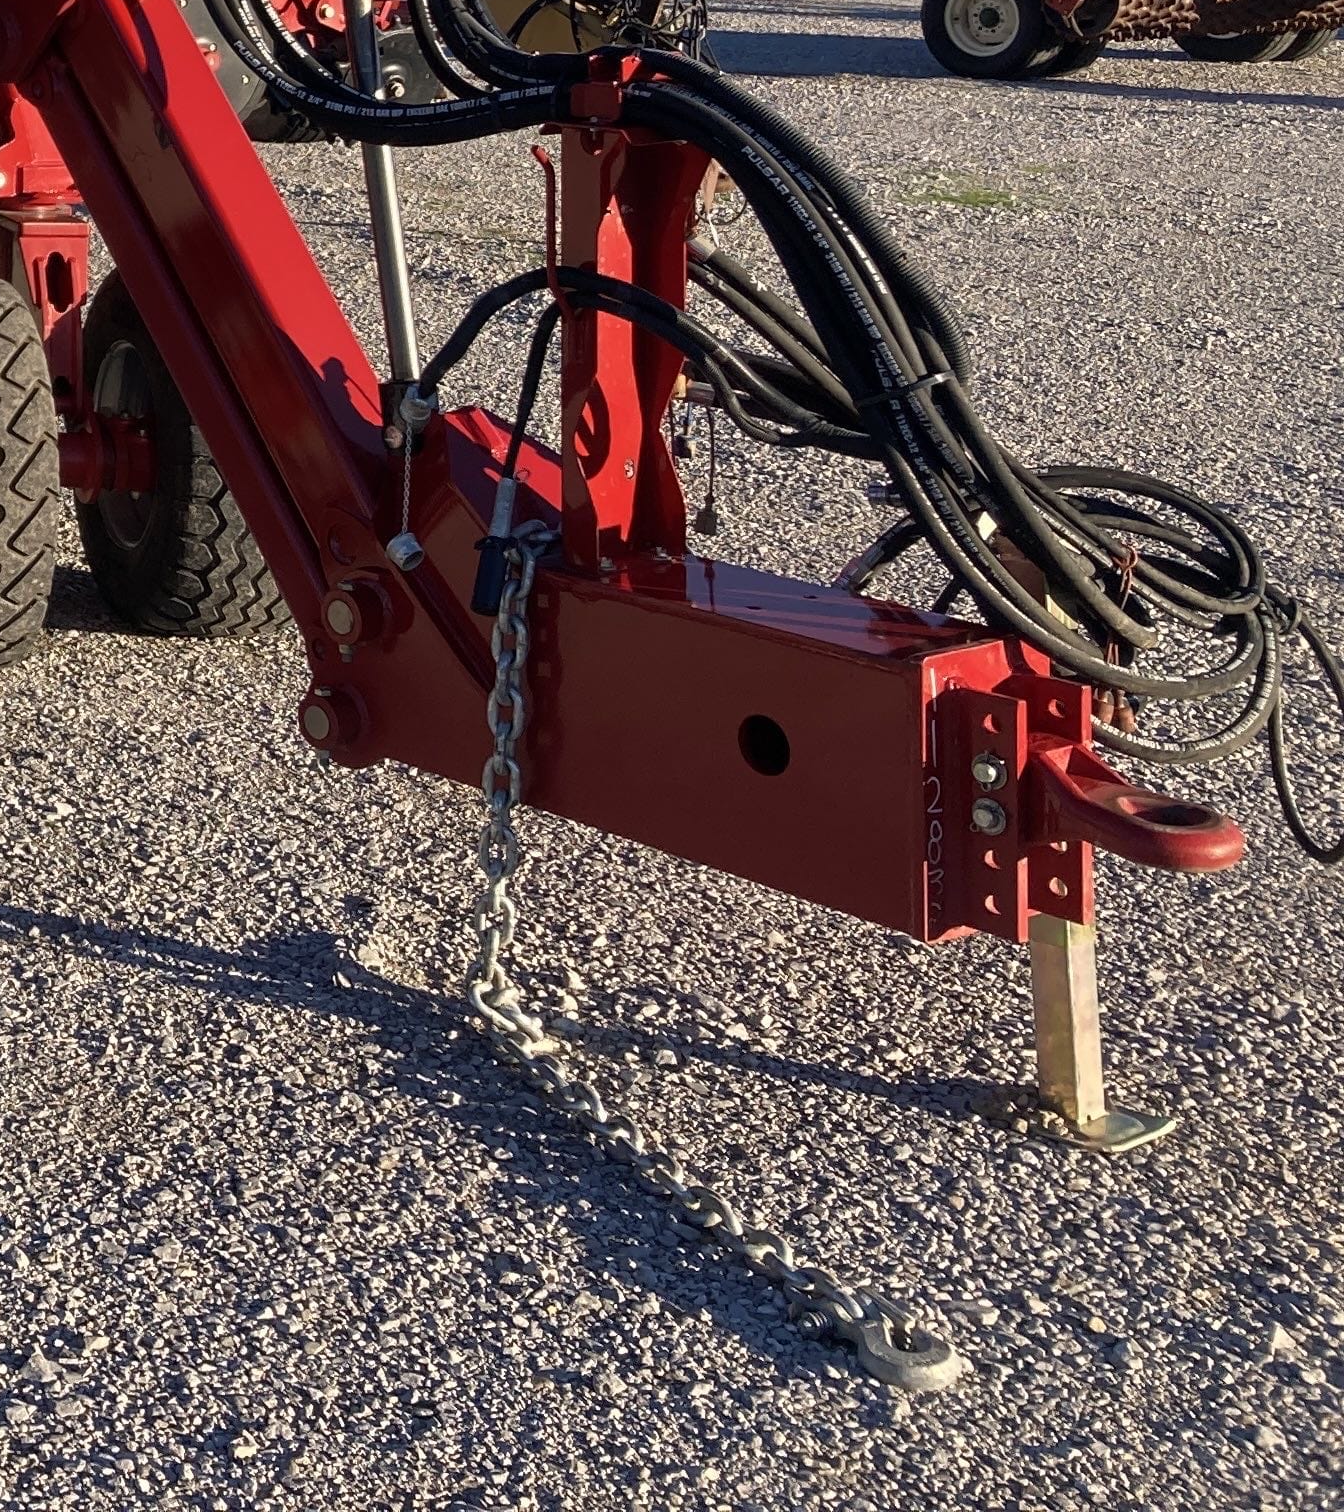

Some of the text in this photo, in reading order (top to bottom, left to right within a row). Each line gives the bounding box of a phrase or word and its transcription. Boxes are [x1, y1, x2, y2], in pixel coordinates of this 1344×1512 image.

[232, 38, 277, 82] PULSAR
[740, 145, 790, 196] PULSAR
[870, 349, 901, 411] PULSR
